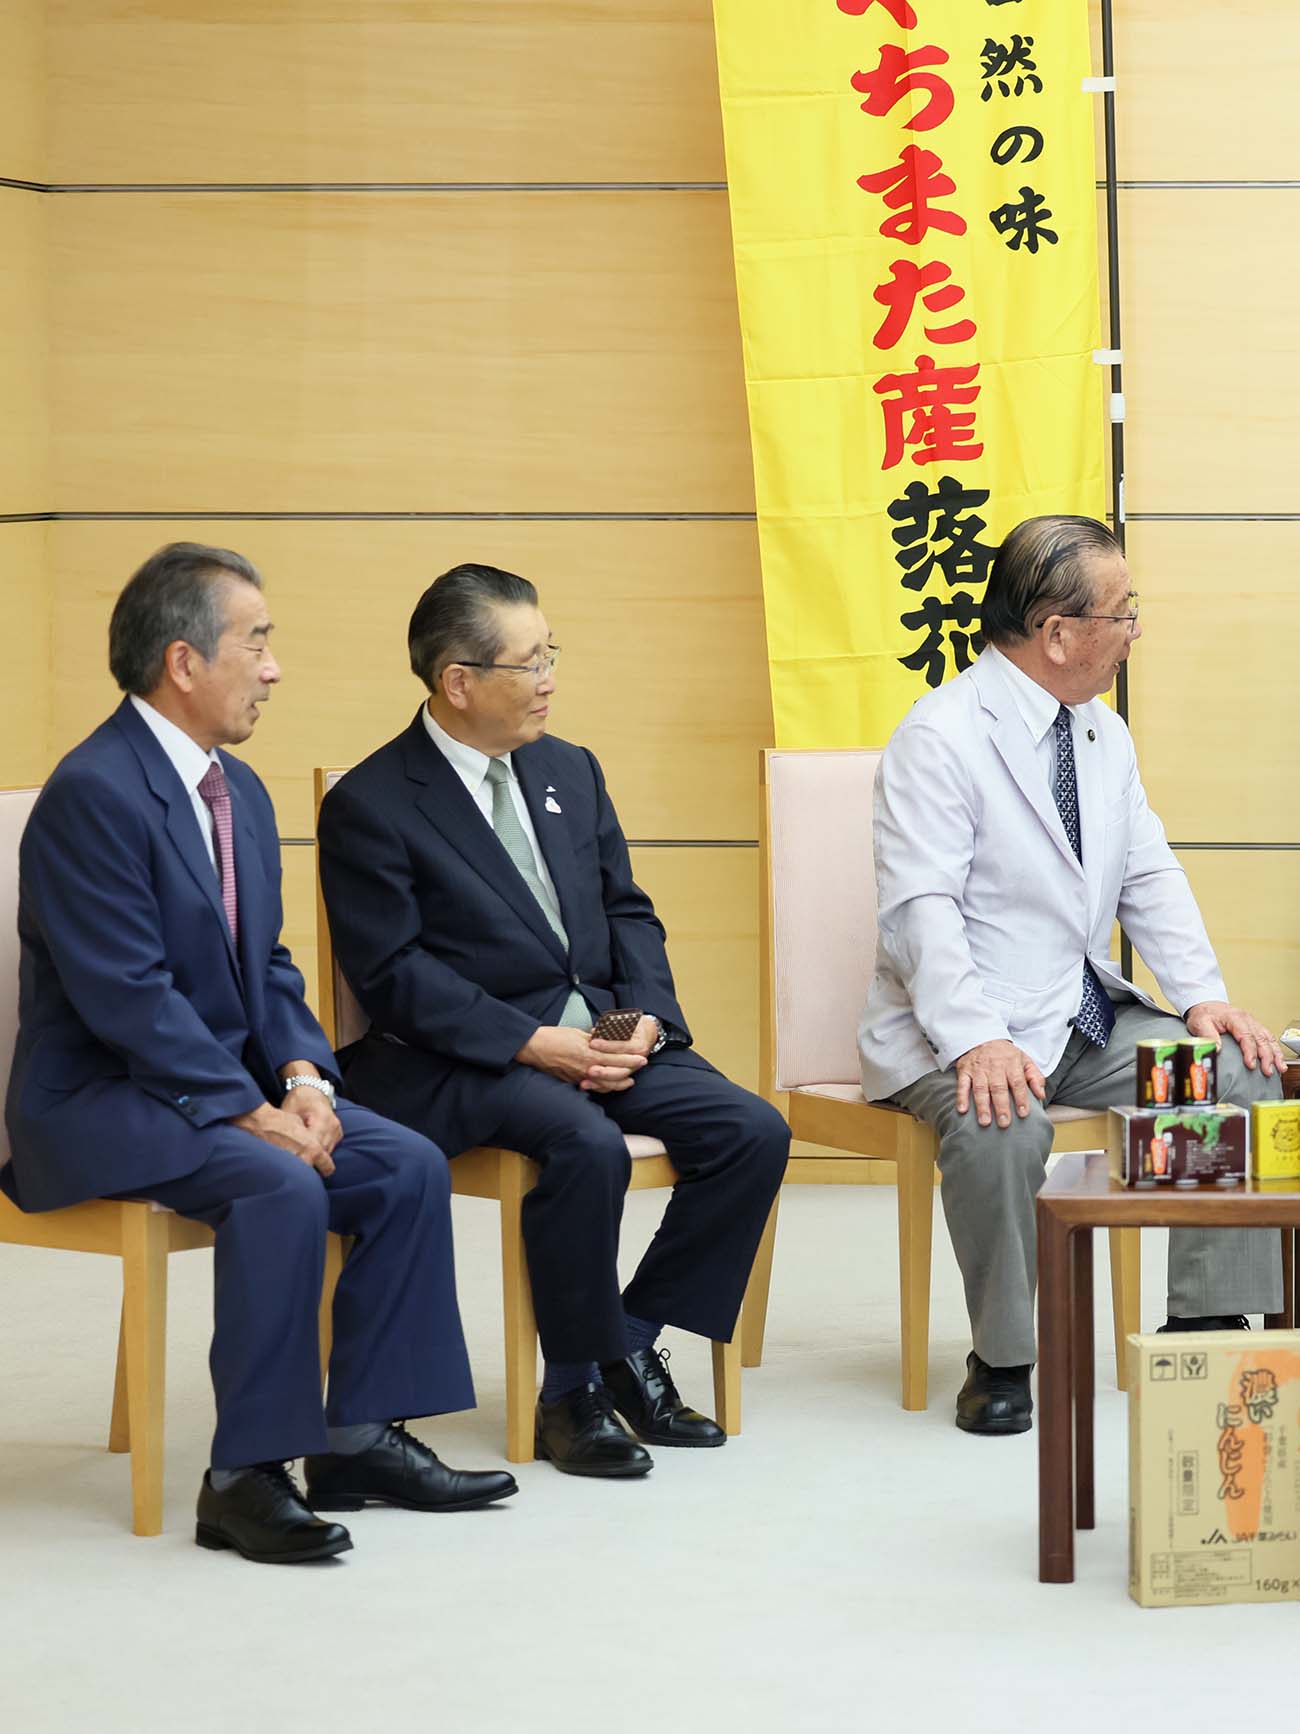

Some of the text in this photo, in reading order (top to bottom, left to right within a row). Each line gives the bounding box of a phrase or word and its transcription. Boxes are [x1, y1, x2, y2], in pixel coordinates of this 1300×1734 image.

[979, 0, 1059, 254] 然の味
[1216, 1402, 1245, 1501] にんじん
